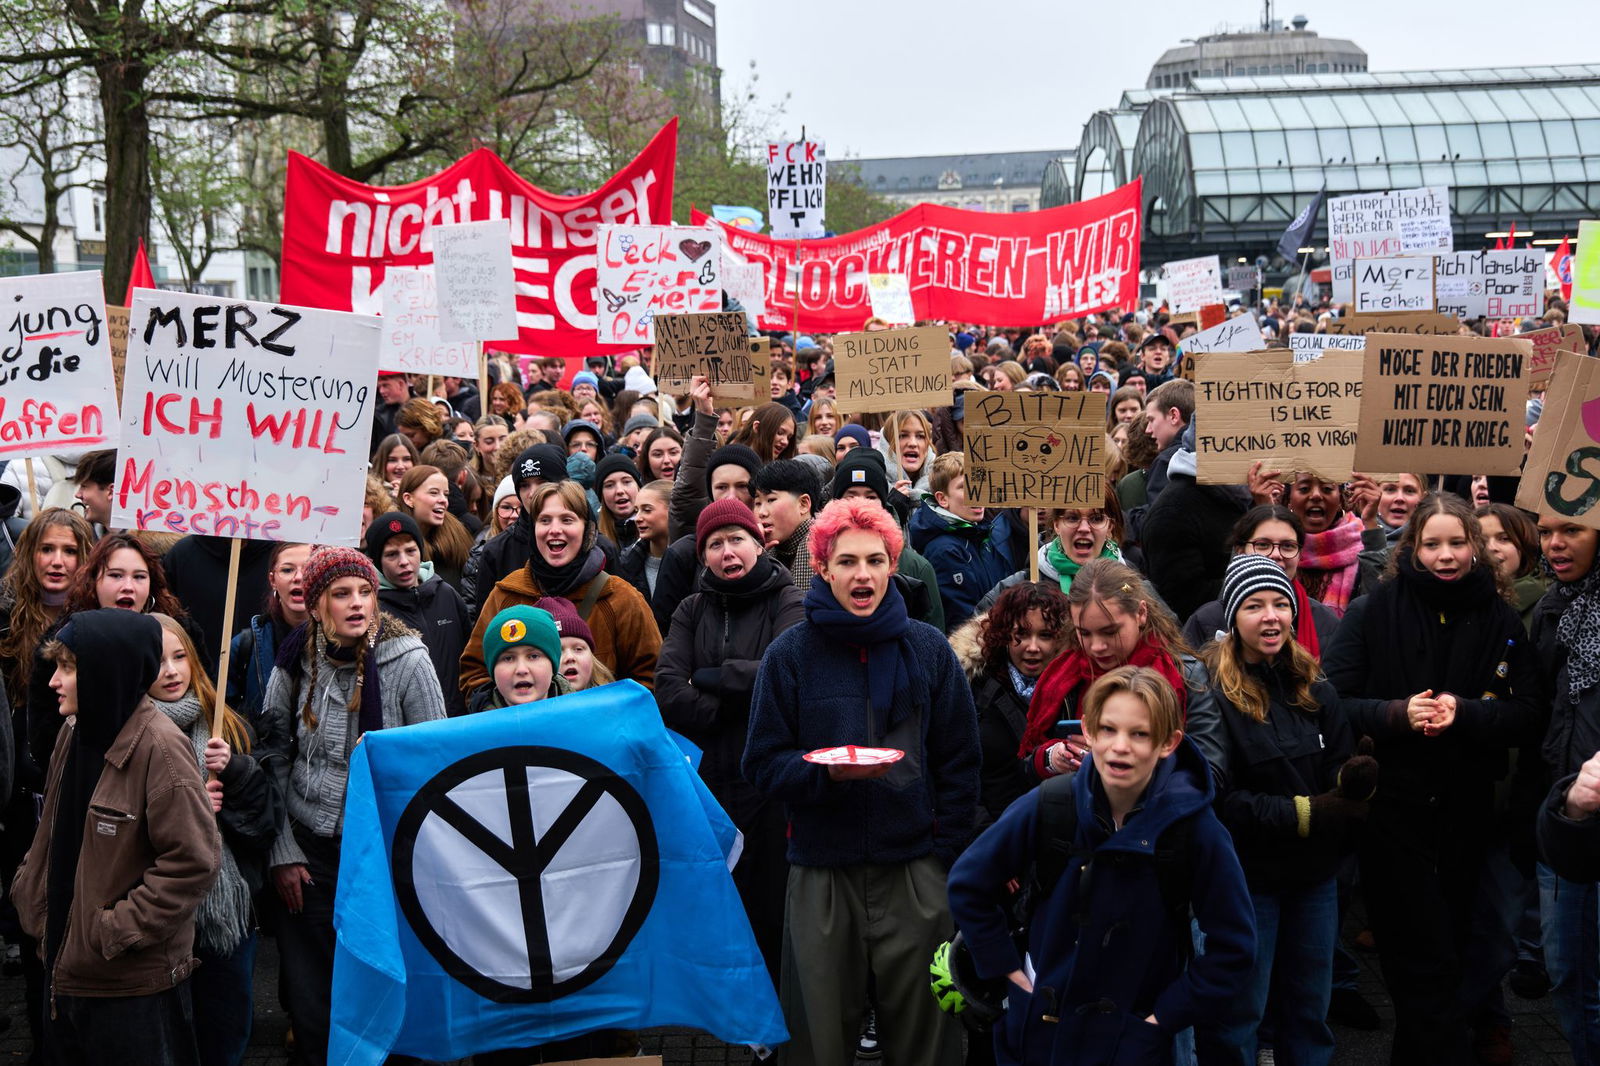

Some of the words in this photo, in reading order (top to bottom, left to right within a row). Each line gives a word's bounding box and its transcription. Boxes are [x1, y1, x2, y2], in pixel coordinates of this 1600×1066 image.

[769, 141, 818, 163] FCK
[769, 163, 823, 187] WEHR
[769, 188, 822, 209] PFLICH
[326, 178, 477, 257] nicht
[489, 169, 657, 249] unser
[789, 211, 806, 228] T
[605, 230, 677, 268] Leck
[1046, 208, 1138, 288] WIR
[622, 269, 699, 292] Eier
[1362, 264, 1431, 284] Merz
[1486, 278, 1520, 296] Poor
[1360, 292, 1425, 310] Freiheit
[2, 295, 103, 363] jung
[144, 306, 302, 356] MERZ
[655, 315, 691, 340] MEIN
[658, 336, 702, 361] MEINE
[844, 335, 920, 359] BILDUNG
[1290, 336, 1324, 349] EQUAL
[27, 346, 81, 382] die
[868, 354, 922, 375] STATT
[1379, 348, 1424, 376] MÖGE
[1431, 350, 1460, 377] DER
[1464, 352, 1524, 379] FRIEDEN
[218, 357, 367, 430] Musterung
[849, 374, 948, 398] MUSTERUNG!
[1200, 381, 1302, 401] FIGHTING
[1306, 382, 1341, 399] FOR
[1394, 384, 1422, 410] MIT
[1426, 384, 1466, 412] EUCH
[1469, 384, 1508, 413] SEIN.
[142, 391, 223, 438] ICH
[976, 394, 1086, 427] BITTI
[1270, 406, 1289, 422] IS
[1293, 405, 1333, 421] LIKE
[1199, 433, 1277, 453] FUCKING
[1281, 432, 1312, 448] FOR
[1382, 418, 1429, 446] NICHT
[1431, 418, 1462, 447] DER
[1465, 420, 1512, 449] KRIEG.
[116, 457, 340, 521] Menschen-
[965, 471, 1105, 504] WEHRPFLICHT
